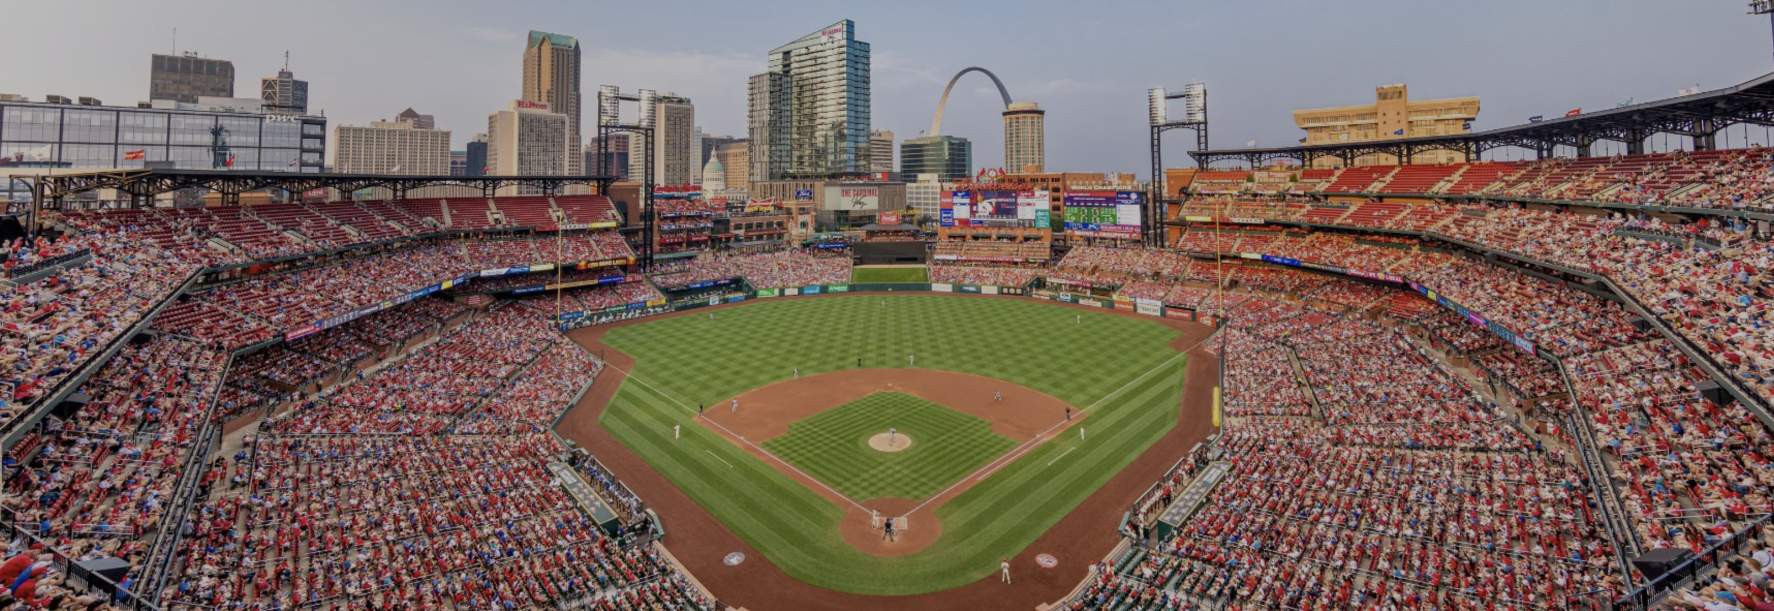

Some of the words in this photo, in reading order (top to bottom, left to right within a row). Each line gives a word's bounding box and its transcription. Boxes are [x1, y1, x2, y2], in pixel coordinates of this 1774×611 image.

[518, 101, 547, 109] Hilton
[265, 115, 299, 123] pwc
[841, 189, 851, 197] ONE
[853, 189, 877, 197] CARDINAL
